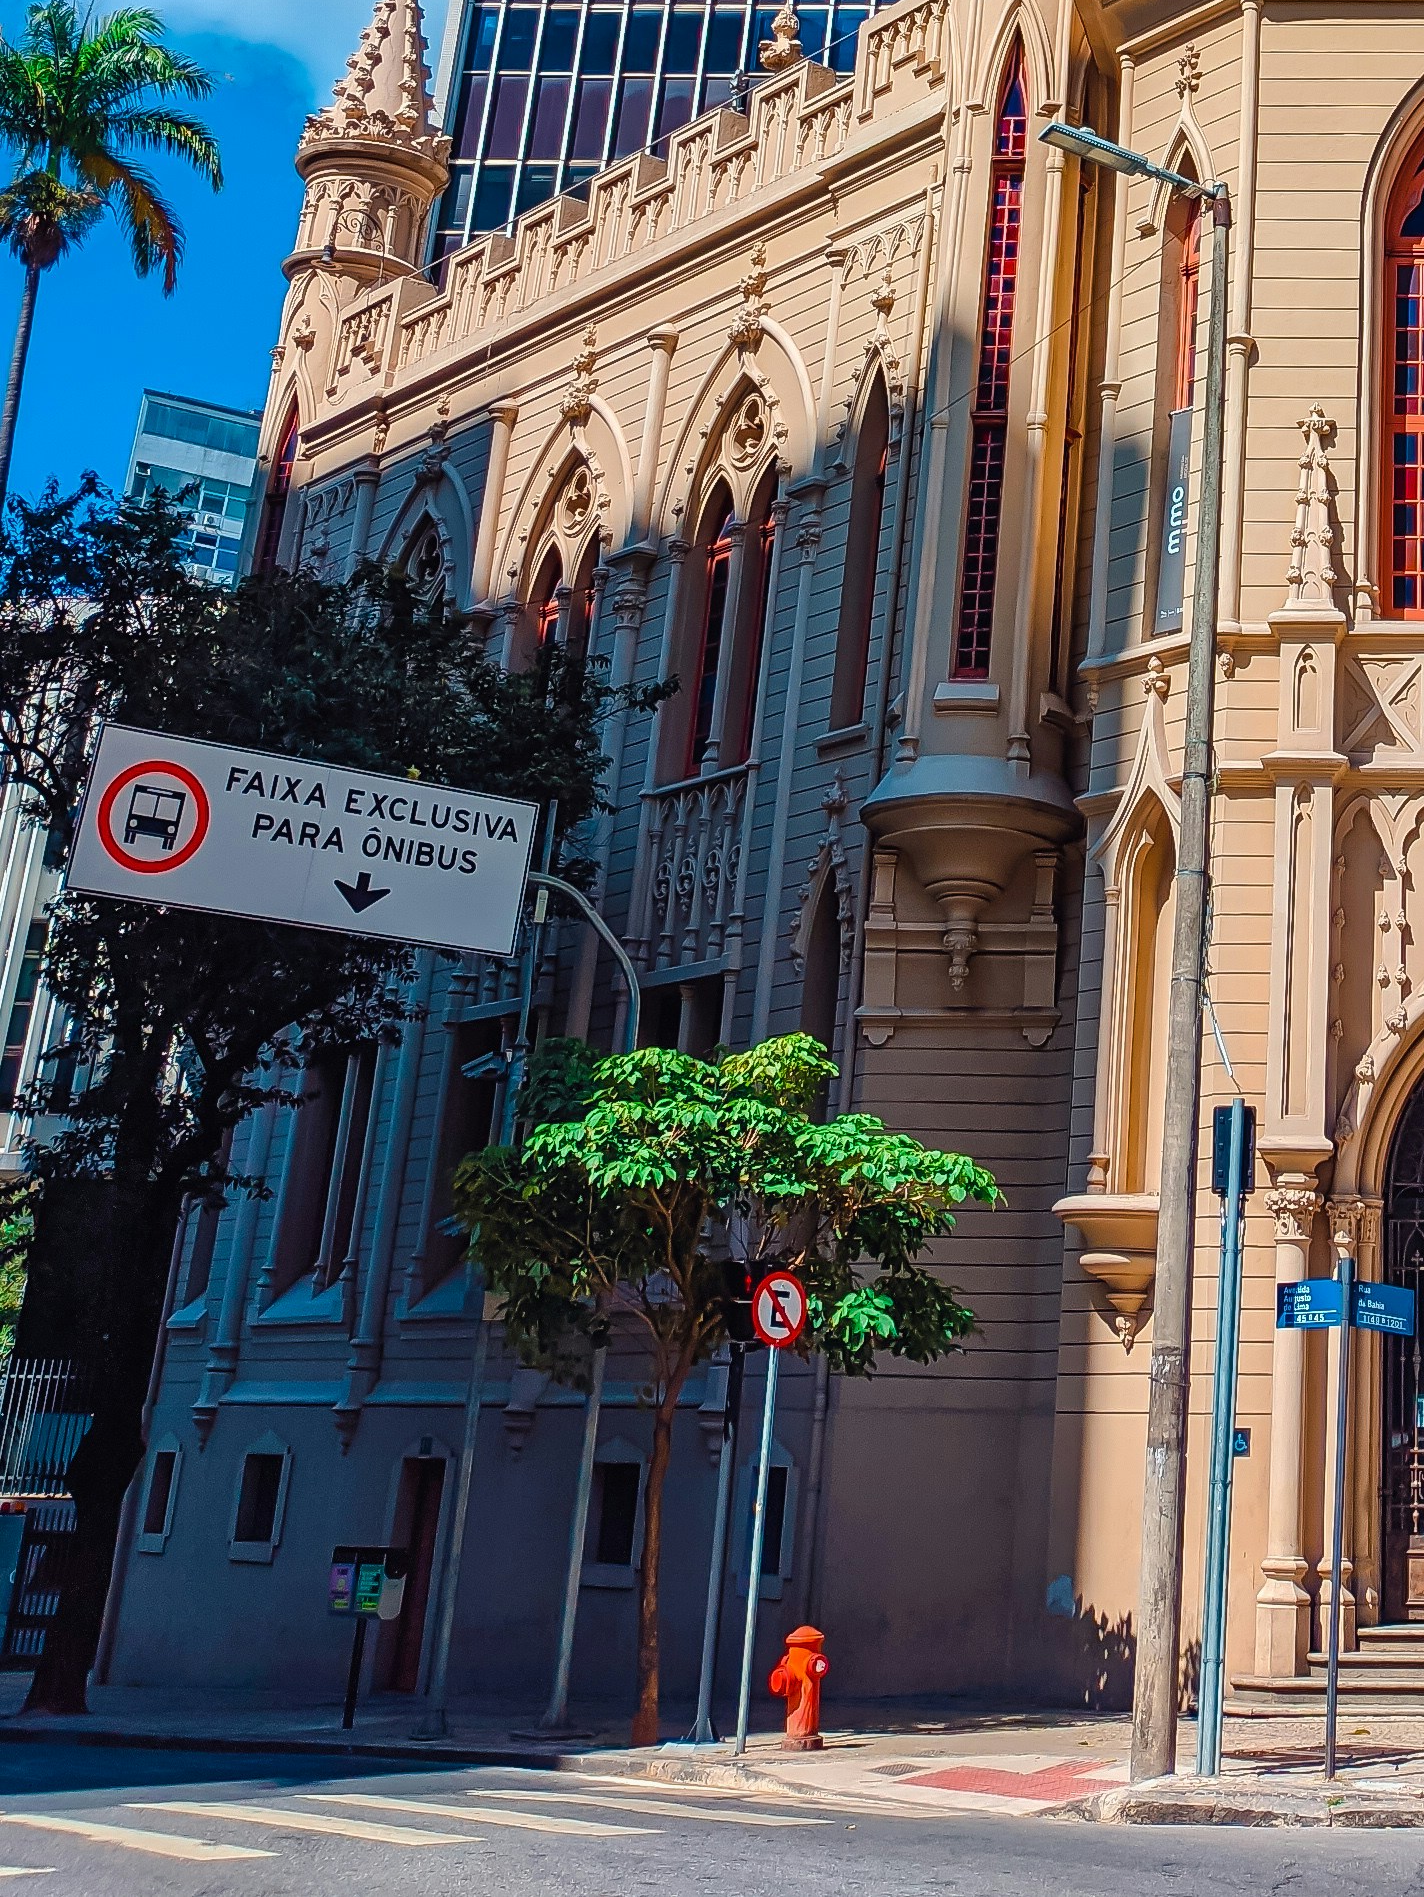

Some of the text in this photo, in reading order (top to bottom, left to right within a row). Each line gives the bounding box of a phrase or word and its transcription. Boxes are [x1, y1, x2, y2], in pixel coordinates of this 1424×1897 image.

[225, 766, 518, 843] FAIXA EXCLUSIVA
[252, 813, 478, 874] PARA ÔNIBUS
[1358, 1285, 1371, 1294] Rua
[1367, 1300, 1385, 1310] Bahia
[770, 1290, 790, 1329] E
